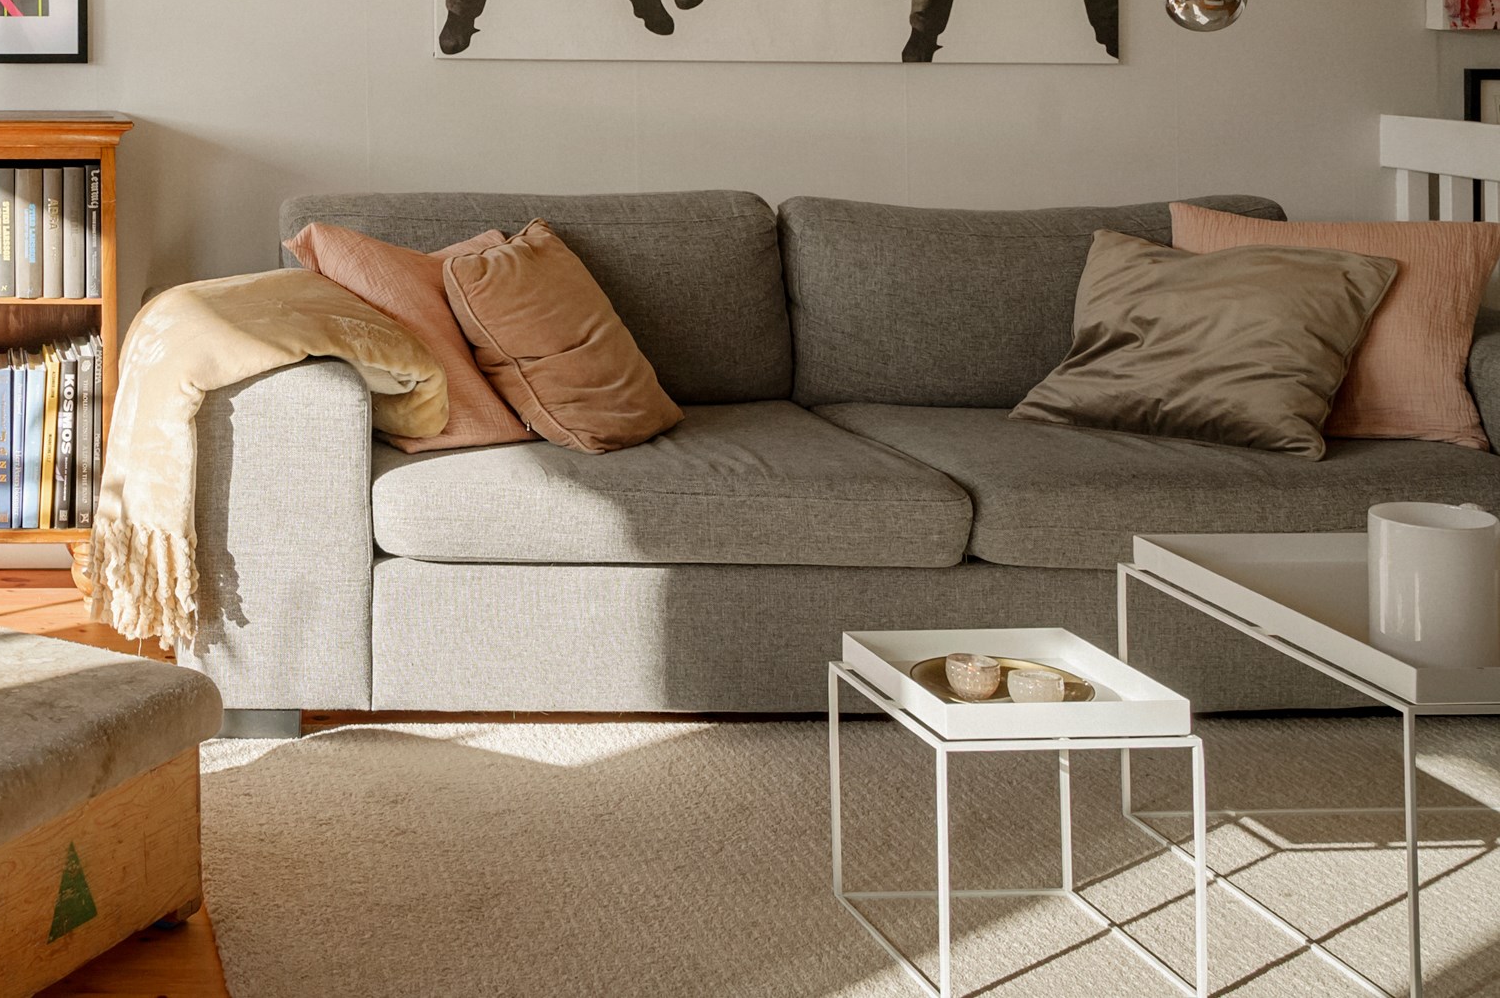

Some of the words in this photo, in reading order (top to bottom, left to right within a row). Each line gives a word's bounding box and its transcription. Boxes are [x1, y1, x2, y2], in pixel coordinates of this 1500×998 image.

[87, 169, 100, 209] Lemmy
[48, 198, 59, 230] ABBA
[60, 373, 76, 455] KOSMOS
[82, 463, 88, 473] ON
